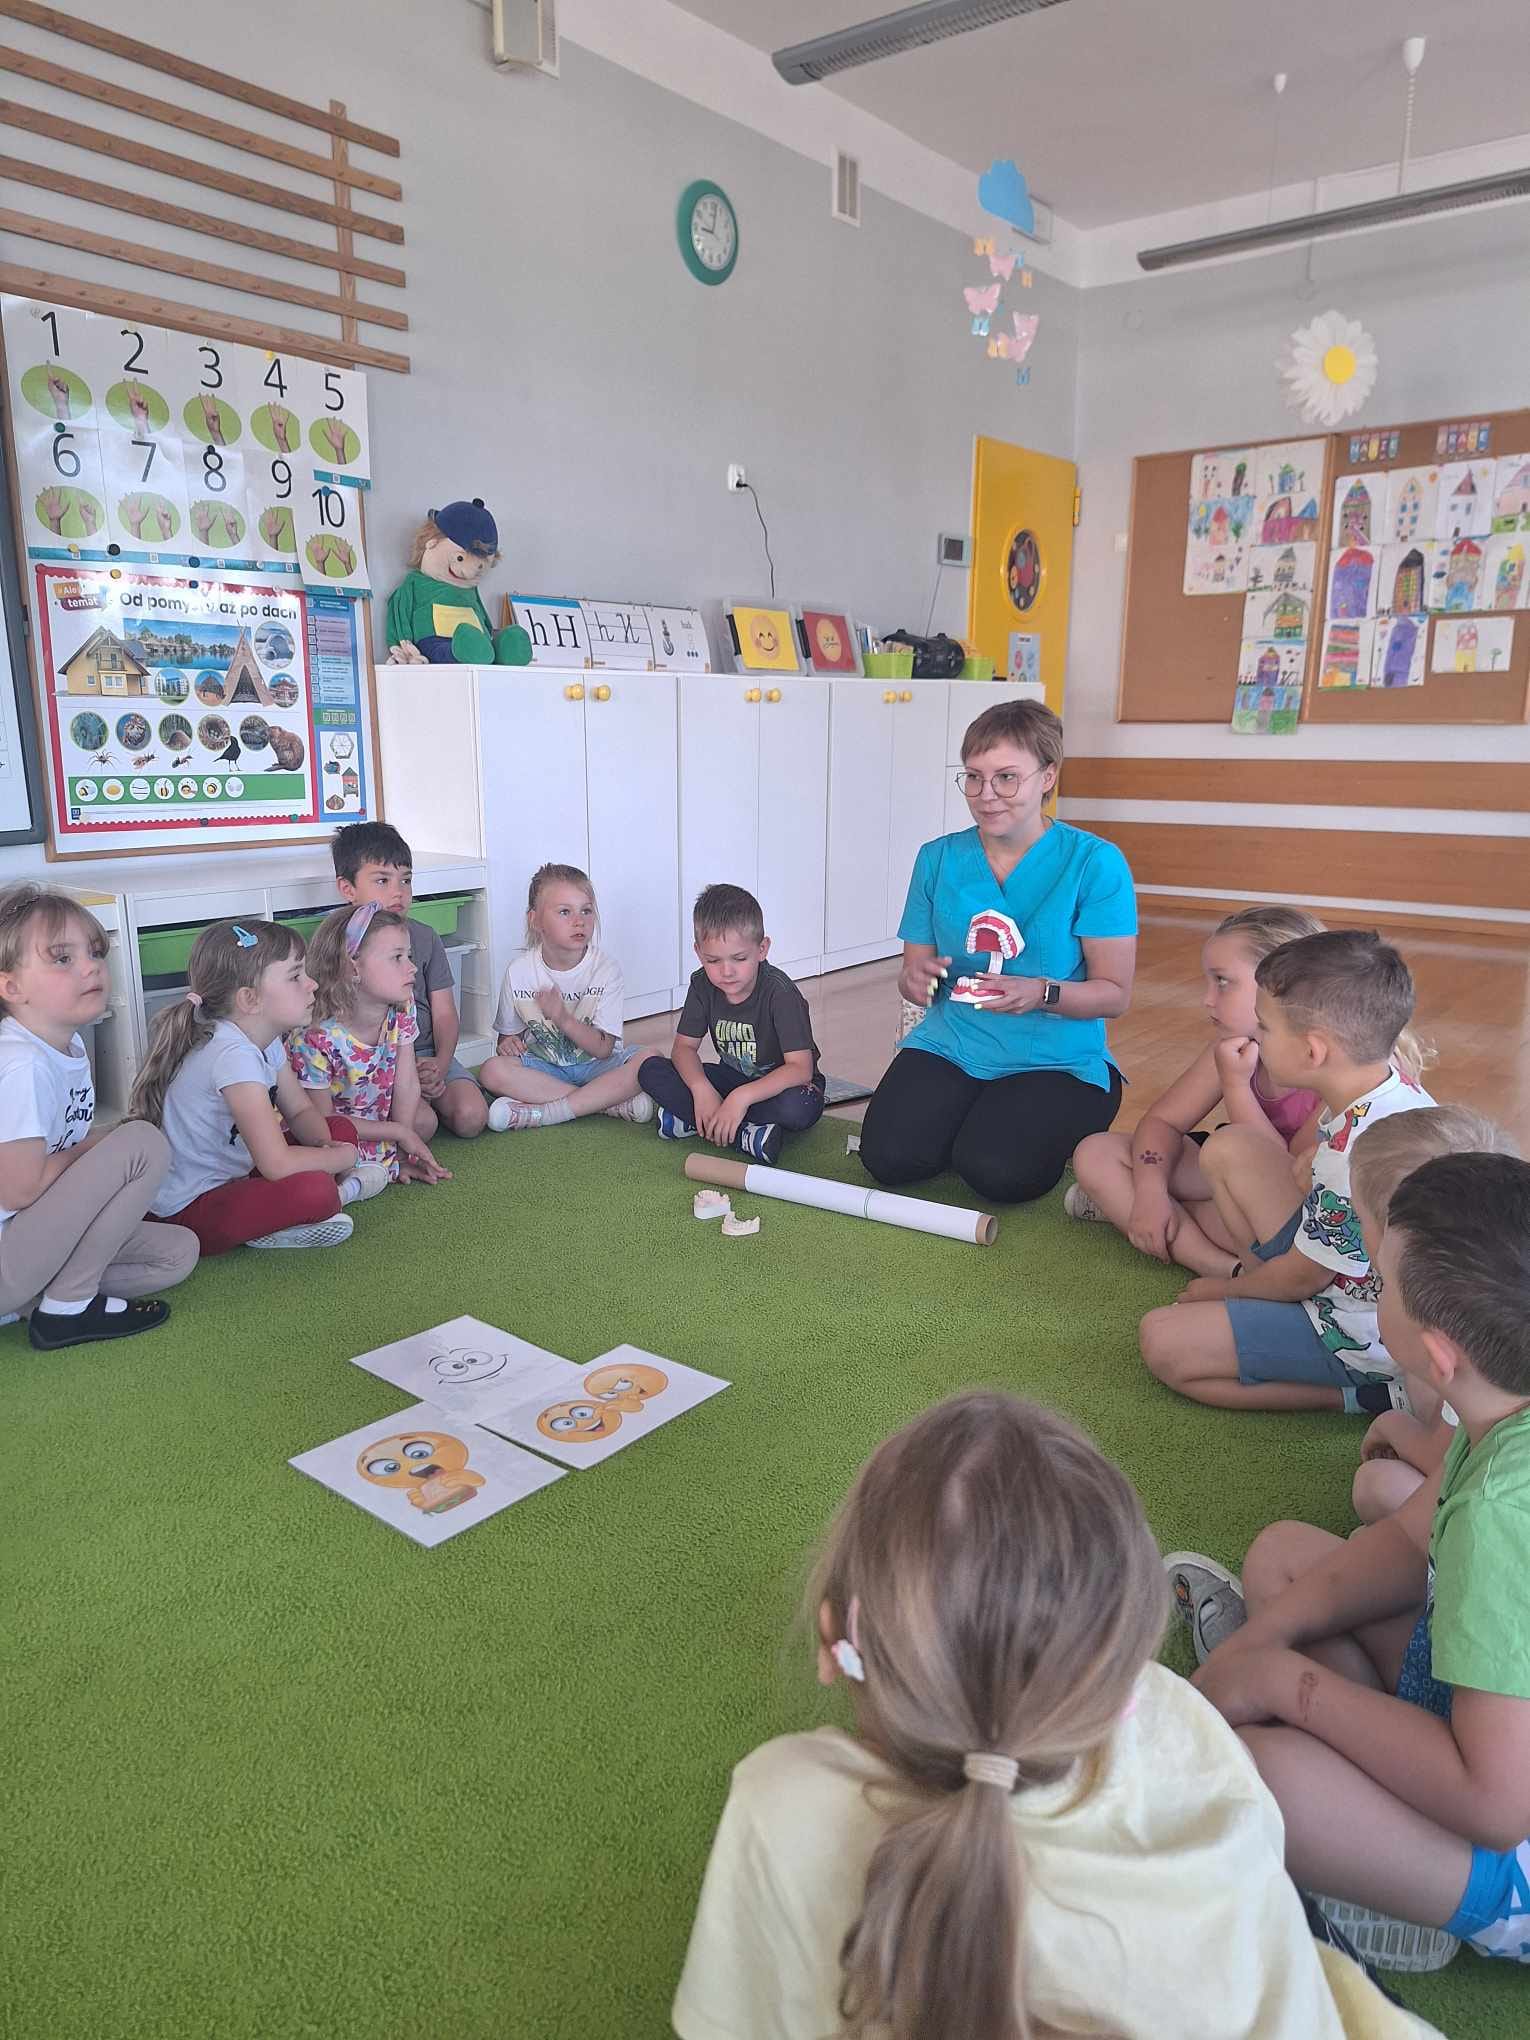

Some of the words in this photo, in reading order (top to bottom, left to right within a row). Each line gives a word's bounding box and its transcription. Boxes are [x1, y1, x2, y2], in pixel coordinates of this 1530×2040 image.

[41, 311, 60, 357] 1
[120, 329, 149, 375] 2
[198, 346, 223, 389] 3
[263, 358, 288, 399] 4
[324, 372, 345, 412] 5
[52, 433, 81, 478] 6
[131, 440, 157, 483] 7
[202, 450, 227, 492] 8
[270, 459, 292, 499] 9
[311, 488, 346, 528] 10
[120, 592, 143, 607] Od
[240, 605, 258, 618] po
[561, 991, 581, 1001] VAN
[715, 1020, 756, 1042] DINO
[717, 1041, 757, 1063] SAUR
